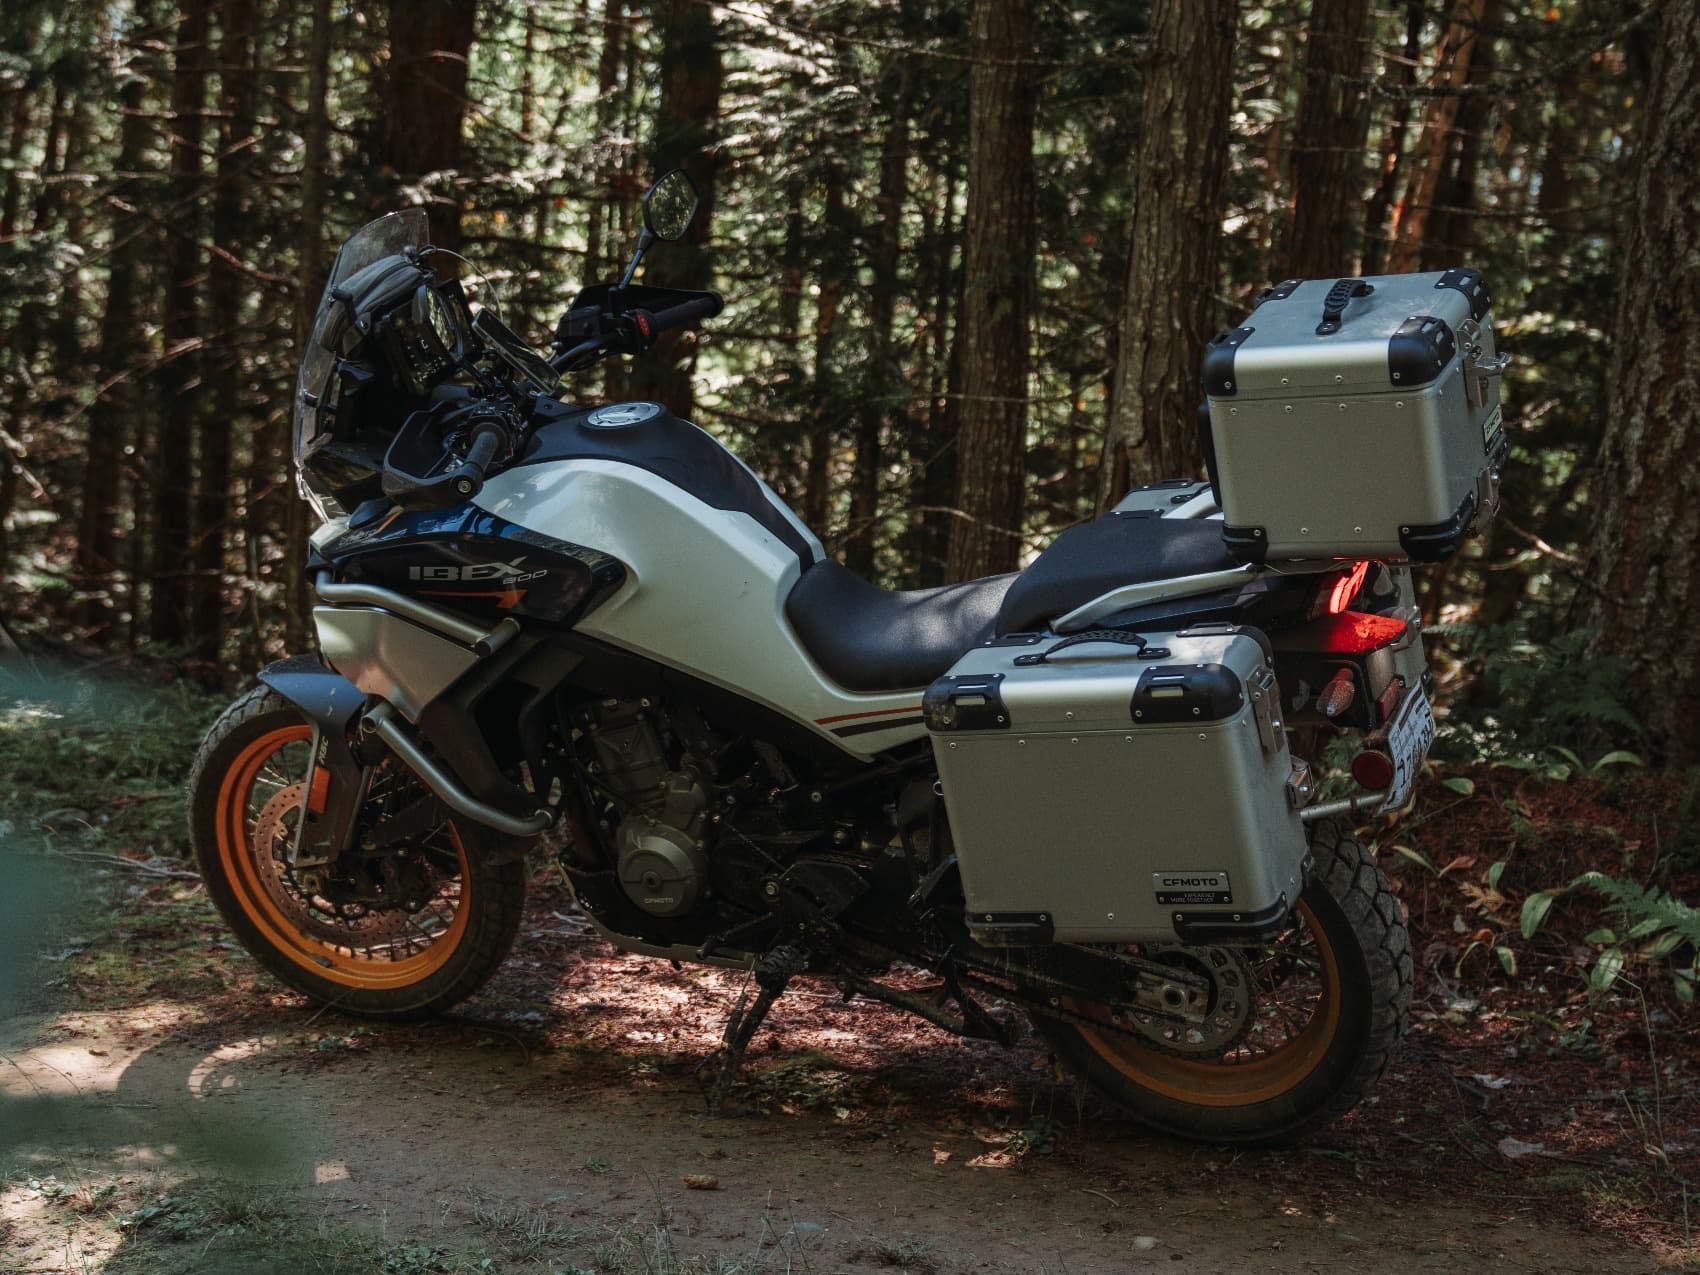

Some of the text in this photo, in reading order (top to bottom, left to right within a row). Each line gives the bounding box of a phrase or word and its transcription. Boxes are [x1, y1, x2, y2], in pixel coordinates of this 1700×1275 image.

[409, 556, 547, 584] IBEX 800
[1162, 878, 1218, 887] CFMOTO
